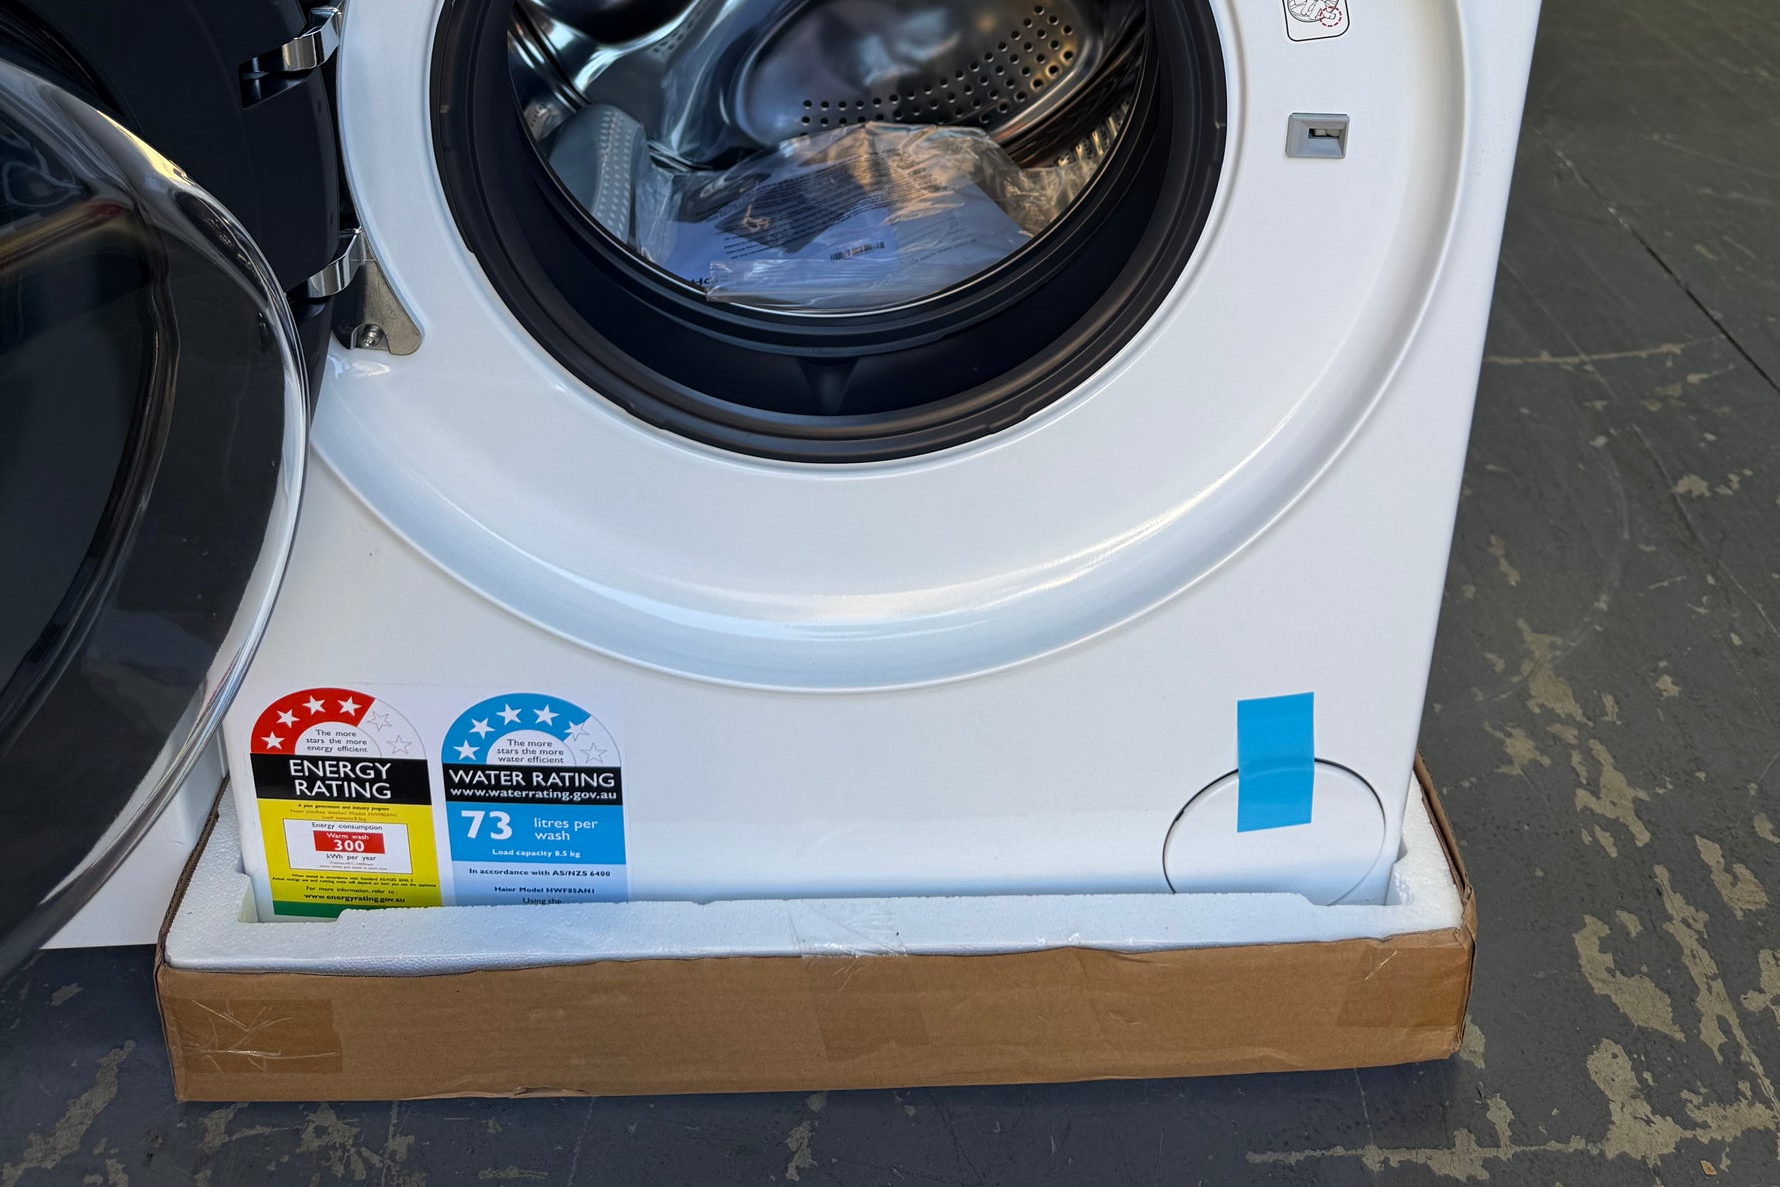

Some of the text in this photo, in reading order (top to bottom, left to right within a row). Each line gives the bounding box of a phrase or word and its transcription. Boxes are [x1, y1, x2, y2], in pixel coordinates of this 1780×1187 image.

[315, 729, 332, 737] The
[507, 739, 525, 747] The
[307, 745, 368, 753] energy efficient
[521, 747, 537, 755] the
[498, 755, 564, 763] water efficient
[289, 759, 392, 780] ENERGY
[449, 769, 615, 787] WATER RATING
[294, 779, 392, 799] RATING
[450, 787, 617, 801] www.waterrating.gov.au
[312, 821, 383, 831] Energy consumption
[461, 810, 513, 840] 73
[533, 817, 598, 831] litres per
[535, 830, 570, 841] wash
[334, 839, 365, 852] 300
[492, 848, 514, 856] Load
[516, 850, 552, 858] capacity
[570, 850, 581, 859] kg
[480, 868, 529, 876] accordance
[304, 892, 406, 903] www.energyrating.gov.au
